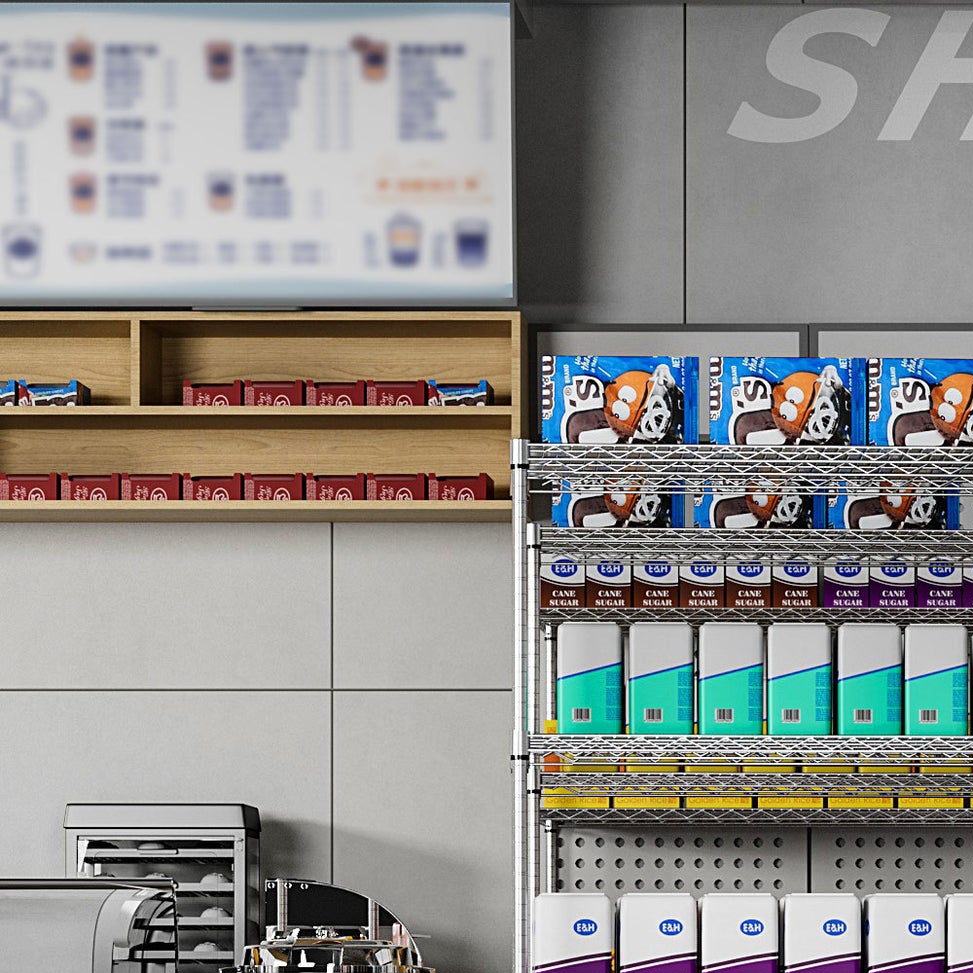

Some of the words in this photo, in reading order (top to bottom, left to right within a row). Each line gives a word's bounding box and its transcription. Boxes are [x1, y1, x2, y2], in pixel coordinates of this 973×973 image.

[577, 924, 595, 932] E&H
[662, 924, 680, 932] E&H
[743, 924, 761, 932] E&H
[826, 924, 844, 932] E&H
[912, 924, 929, 932] E&H
